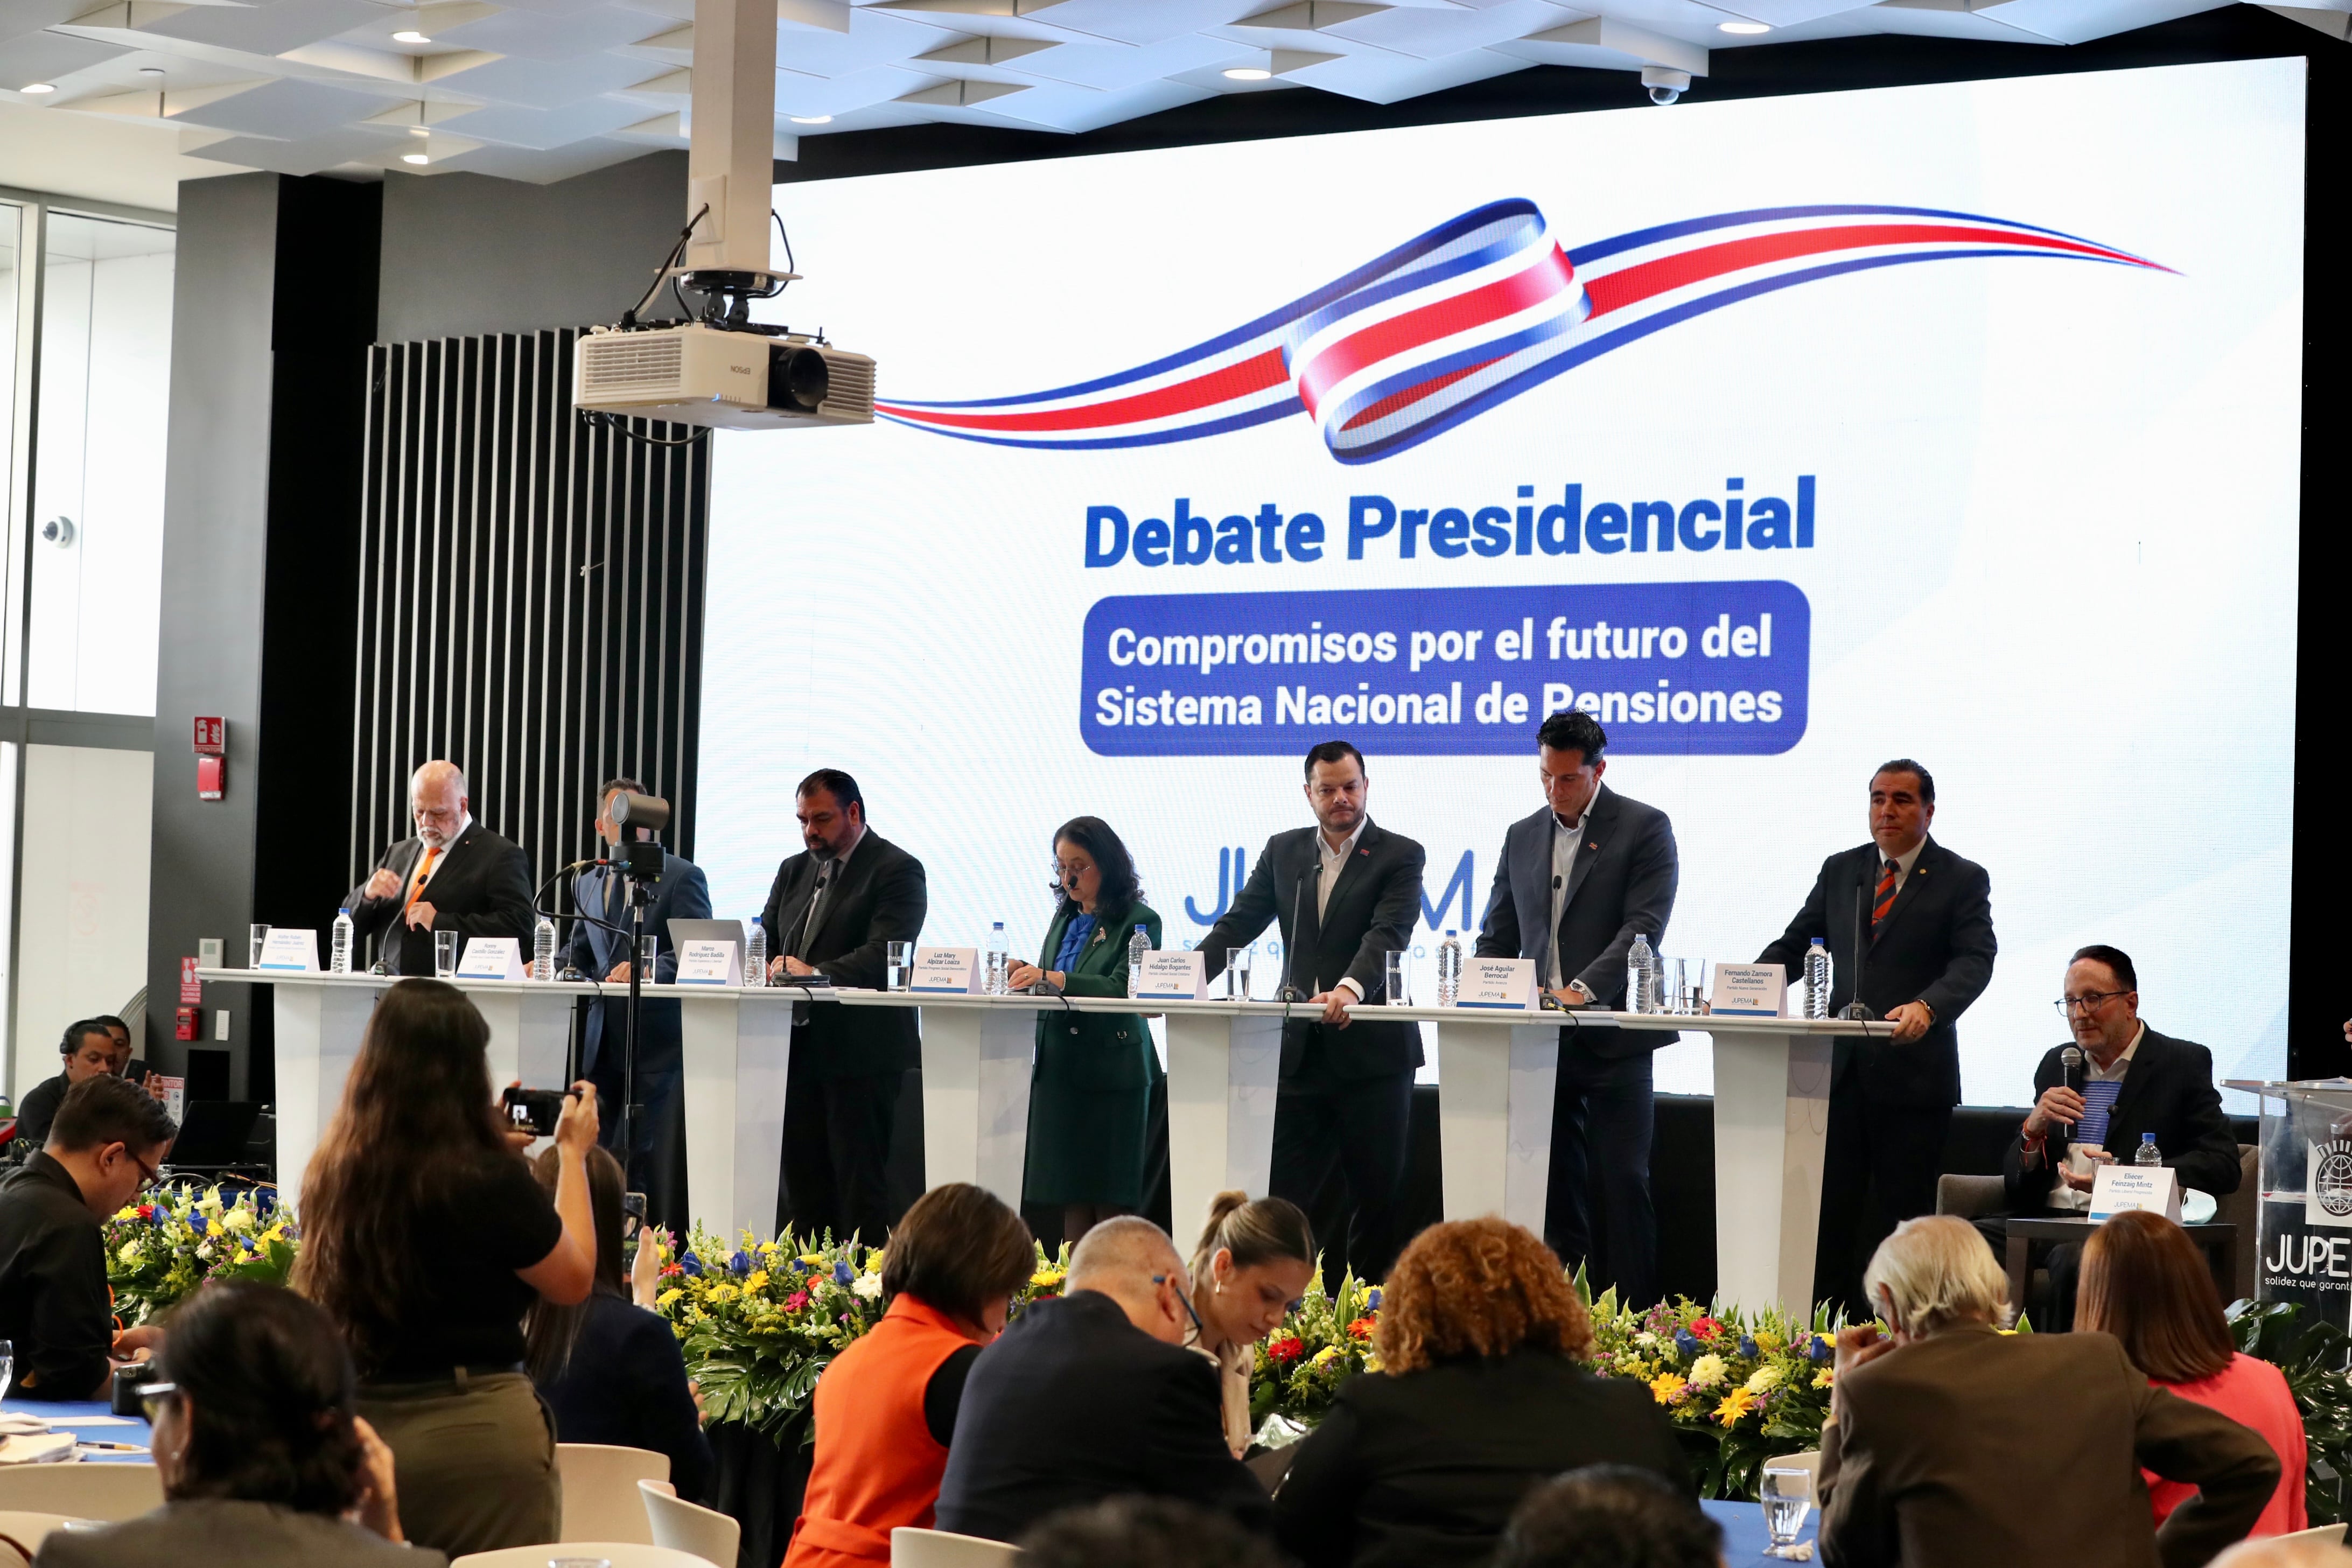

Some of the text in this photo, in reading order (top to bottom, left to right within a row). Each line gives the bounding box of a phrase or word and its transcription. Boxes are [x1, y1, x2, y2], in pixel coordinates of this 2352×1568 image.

[730, 365, 751, 375] EPSON
[1084, 474, 1817, 569] Debate Presidencial
[1108, 613, 1772, 674] Compromisos por el futuro del
[1096, 679, 1782, 726] Sistema Nacional de Pensiones
[2111, 1180, 2136, 1188] Feinzaig
[2266, 1234, 2352, 1278] JUPE
[2265, 1276, 2297, 1286] solidez
[2299, 1280, 2316, 1290] que
